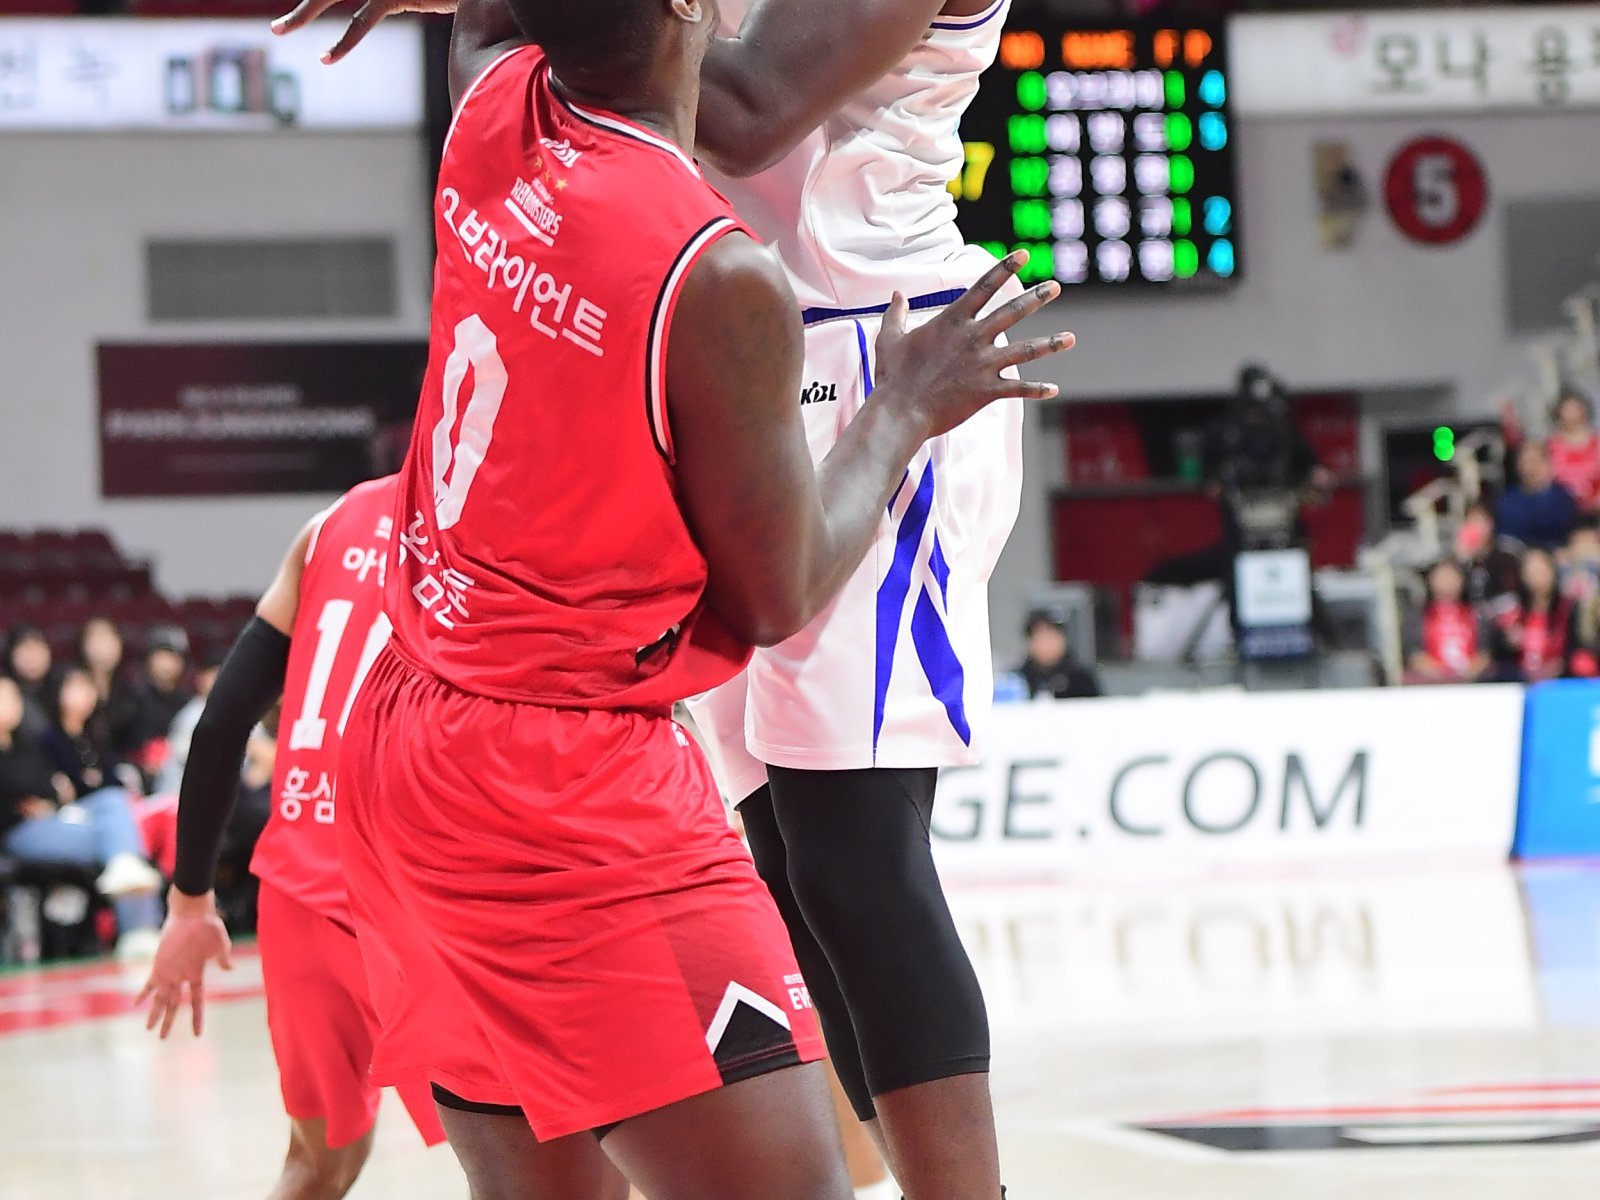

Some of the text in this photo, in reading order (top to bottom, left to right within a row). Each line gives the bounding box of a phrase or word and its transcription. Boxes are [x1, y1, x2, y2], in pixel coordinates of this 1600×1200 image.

[1412, 153, 1461, 231] 5
[433, 313, 509, 531] 0
[800, 381, 838, 406] KBL
